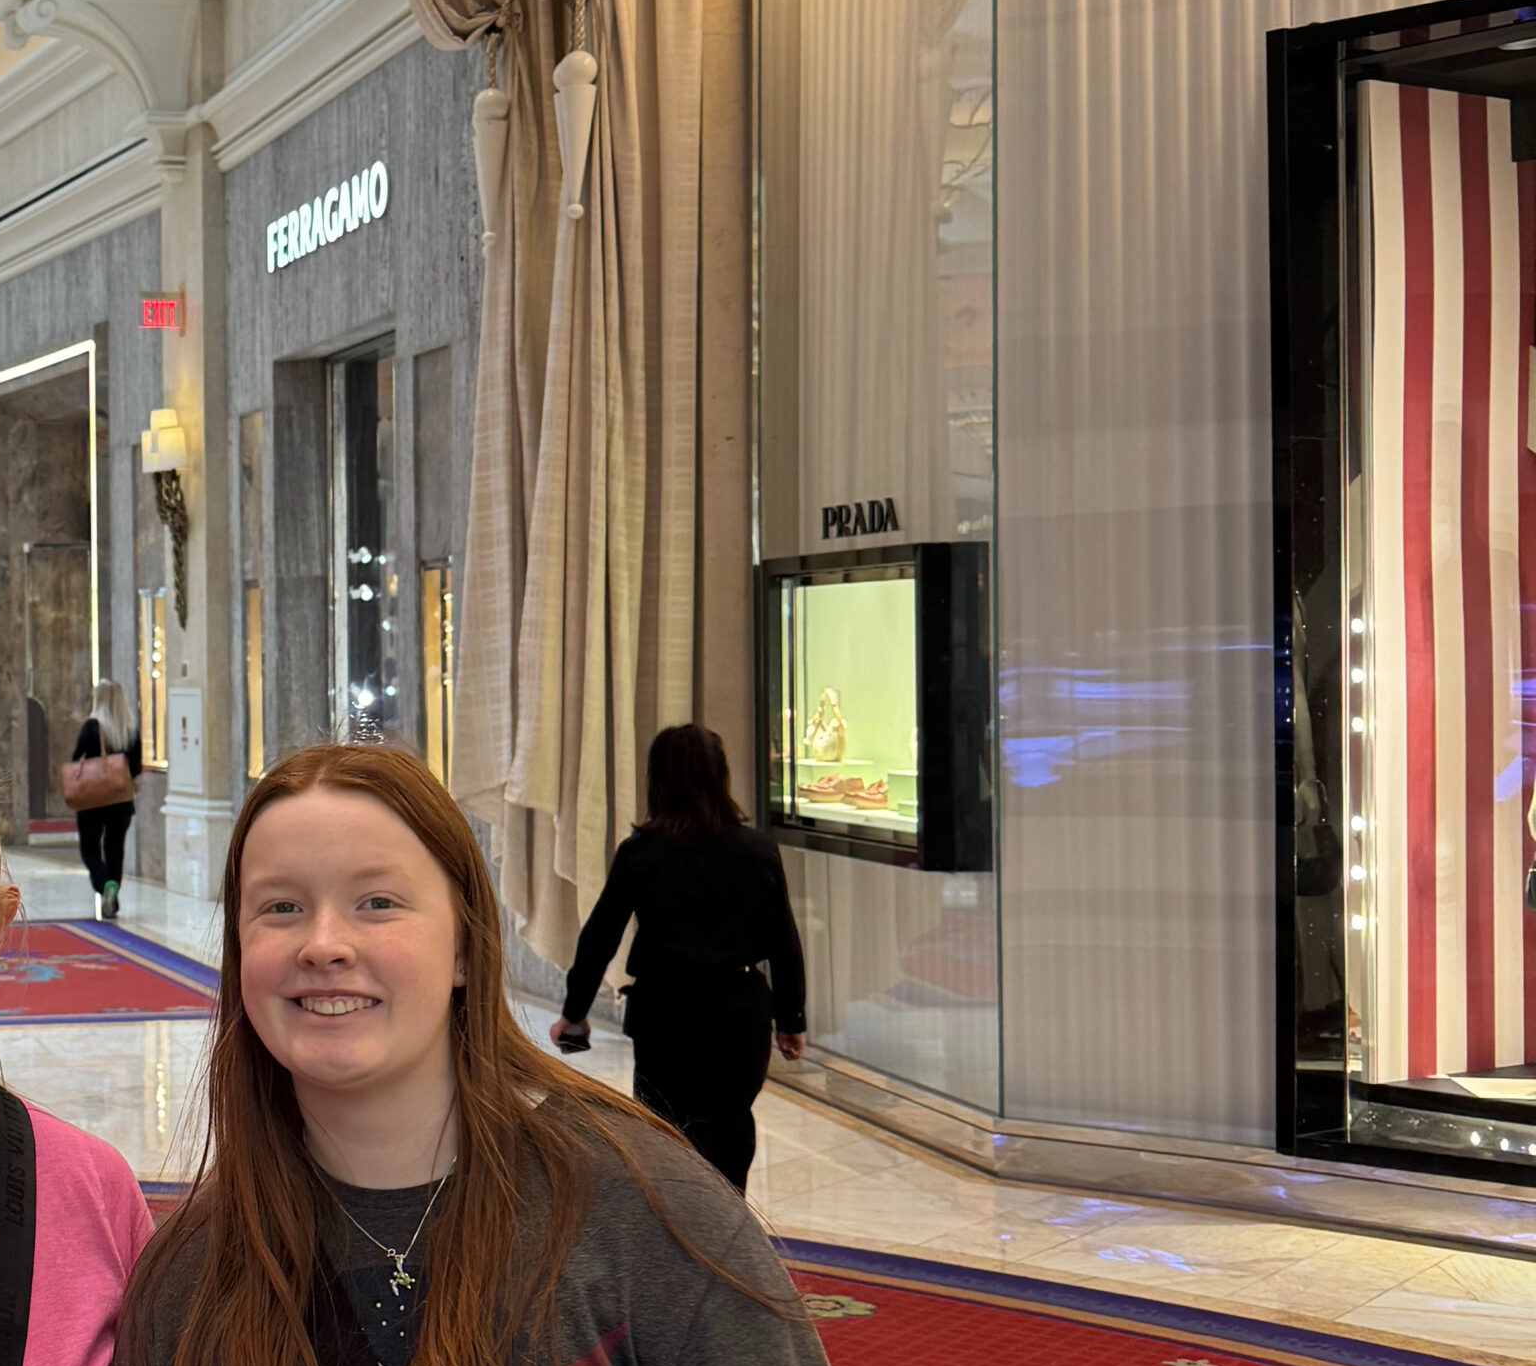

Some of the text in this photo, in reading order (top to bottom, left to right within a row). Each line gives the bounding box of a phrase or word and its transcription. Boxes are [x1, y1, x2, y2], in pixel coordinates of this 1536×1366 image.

[266, 160, 389, 274] FERRAGAMO
[142, 299, 177, 327] EXIT
[822, 497, 900, 540] PRADA
[0, 1086, 25, 1156] VUITTO
